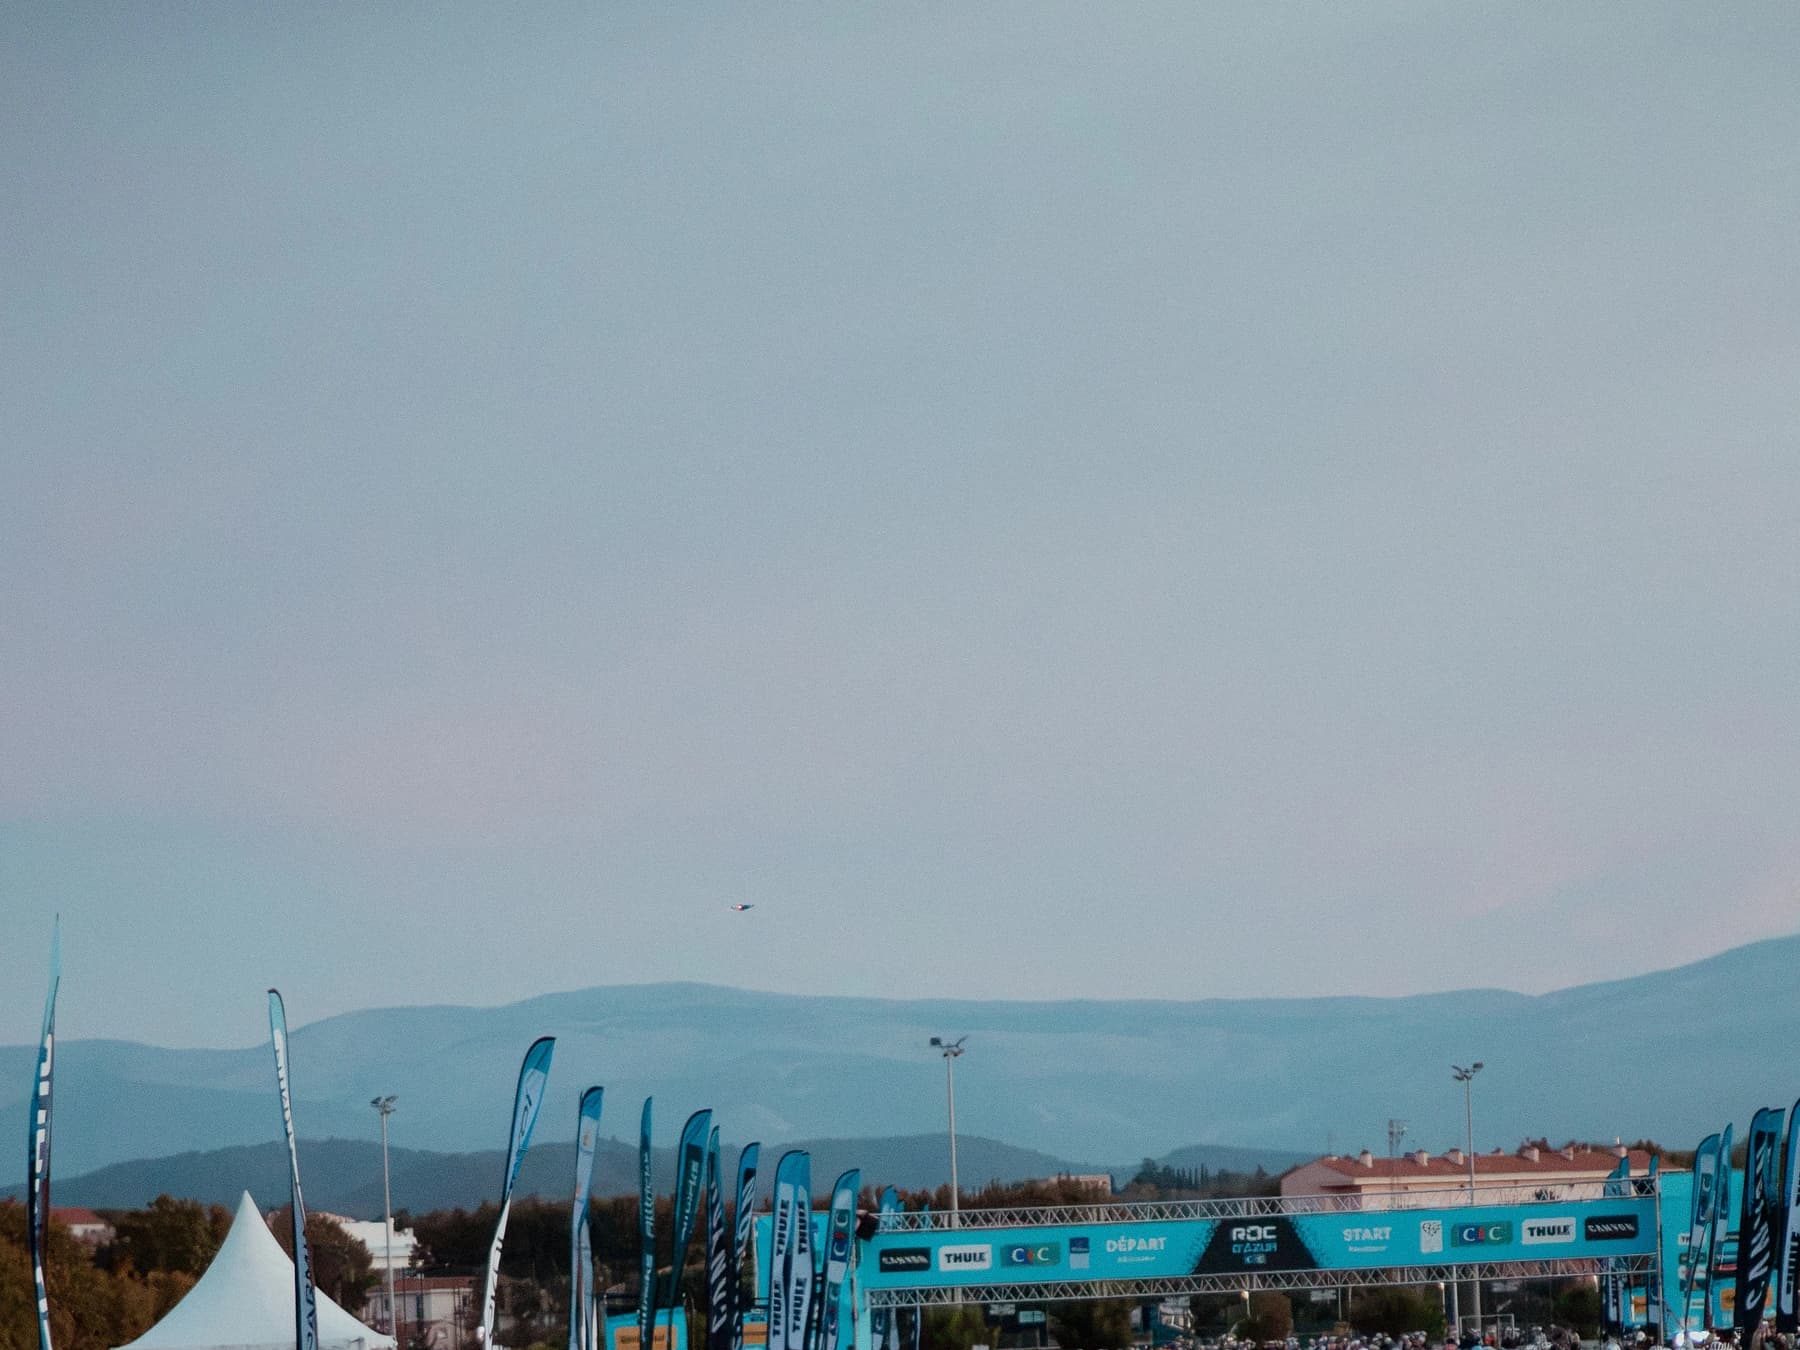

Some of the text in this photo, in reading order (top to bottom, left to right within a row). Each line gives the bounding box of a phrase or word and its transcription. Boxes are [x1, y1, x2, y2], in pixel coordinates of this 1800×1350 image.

[1232, 1225, 1277, 1242] ROC
[1343, 1227, 1392, 1242] START
[1528, 1225, 1570, 1237] THULE
[1106, 1235, 1167, 1253] DÉPART
[945, 1252, 985, 1263] THULE
